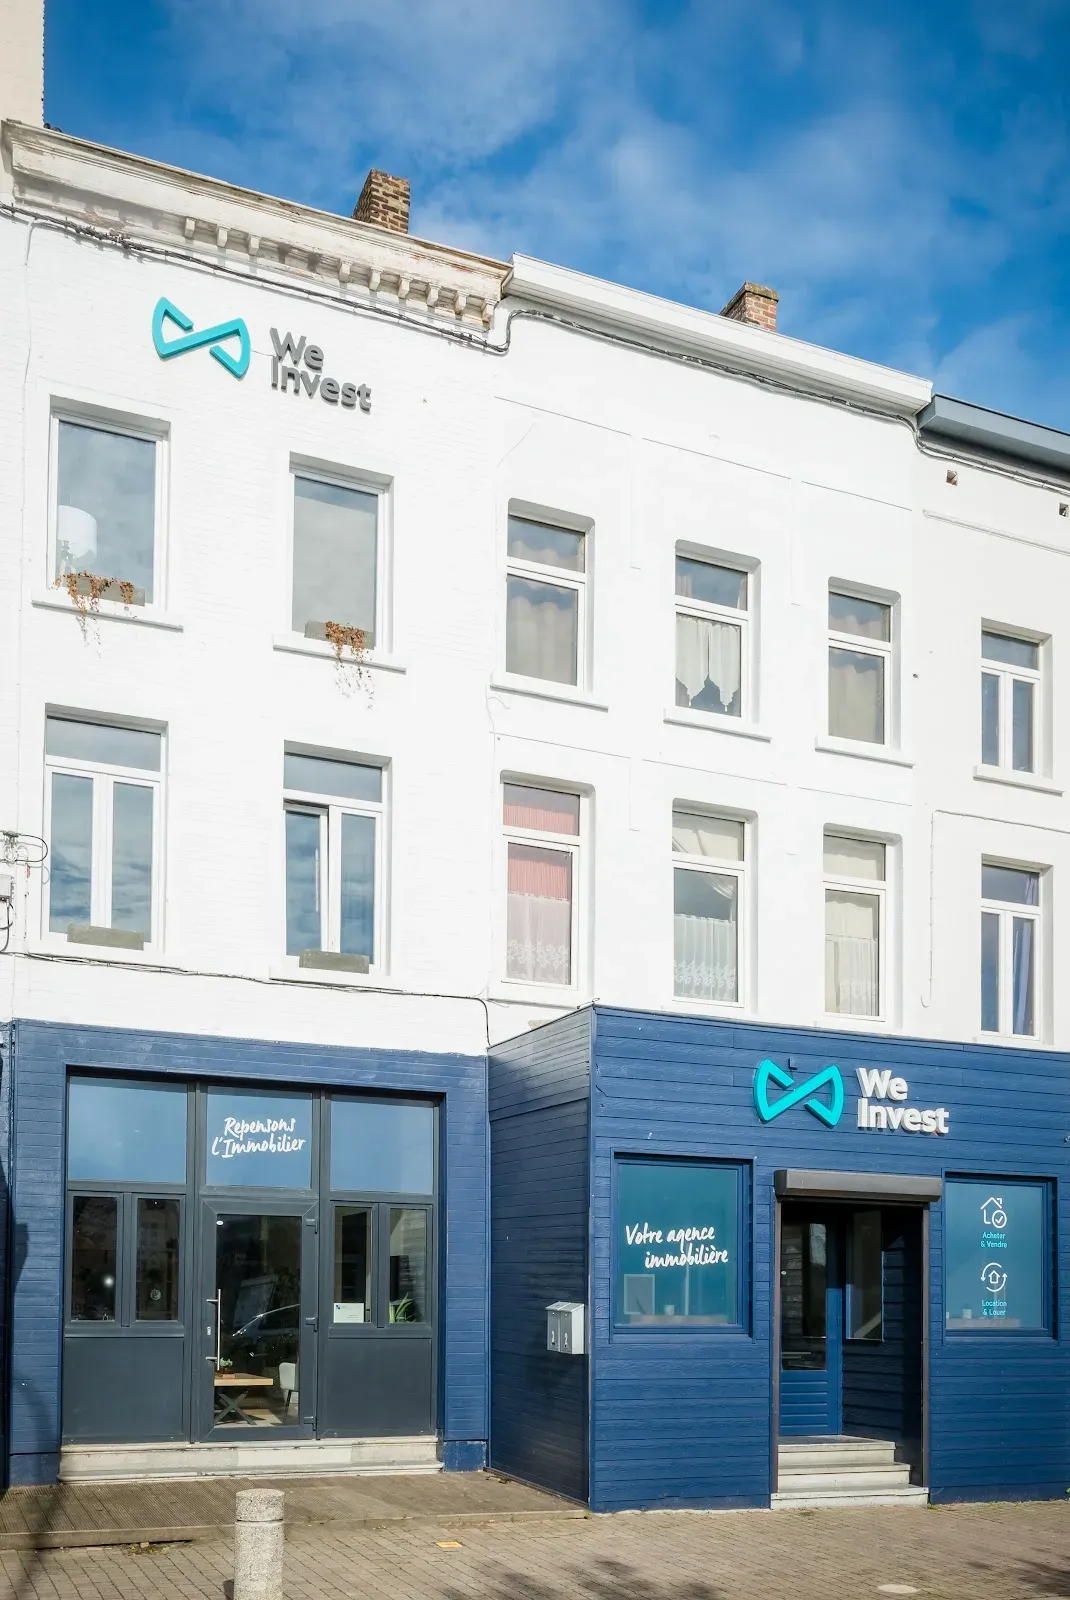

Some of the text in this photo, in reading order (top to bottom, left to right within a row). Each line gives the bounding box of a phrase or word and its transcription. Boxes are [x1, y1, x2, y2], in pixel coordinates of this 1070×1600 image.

[269, 327, 325, 372] We
[271, 355, 372, 412] Invest
[855, 1067, 908, 1101] We
[223, 1117, 297, 1142] Repensons
[857, 1098, 950, 1134] Invest
[625, 1221, 716, 1254] Votre agence
[980, 1240, 1008, 1249] & Vendre
[982, 1231, 1006, 1240] Acheter
[644, 1242, 729, 1269] immobilière
[981, 1299, 1008, 1307] Location
[988, 1308, 1007, 1316] Louer
